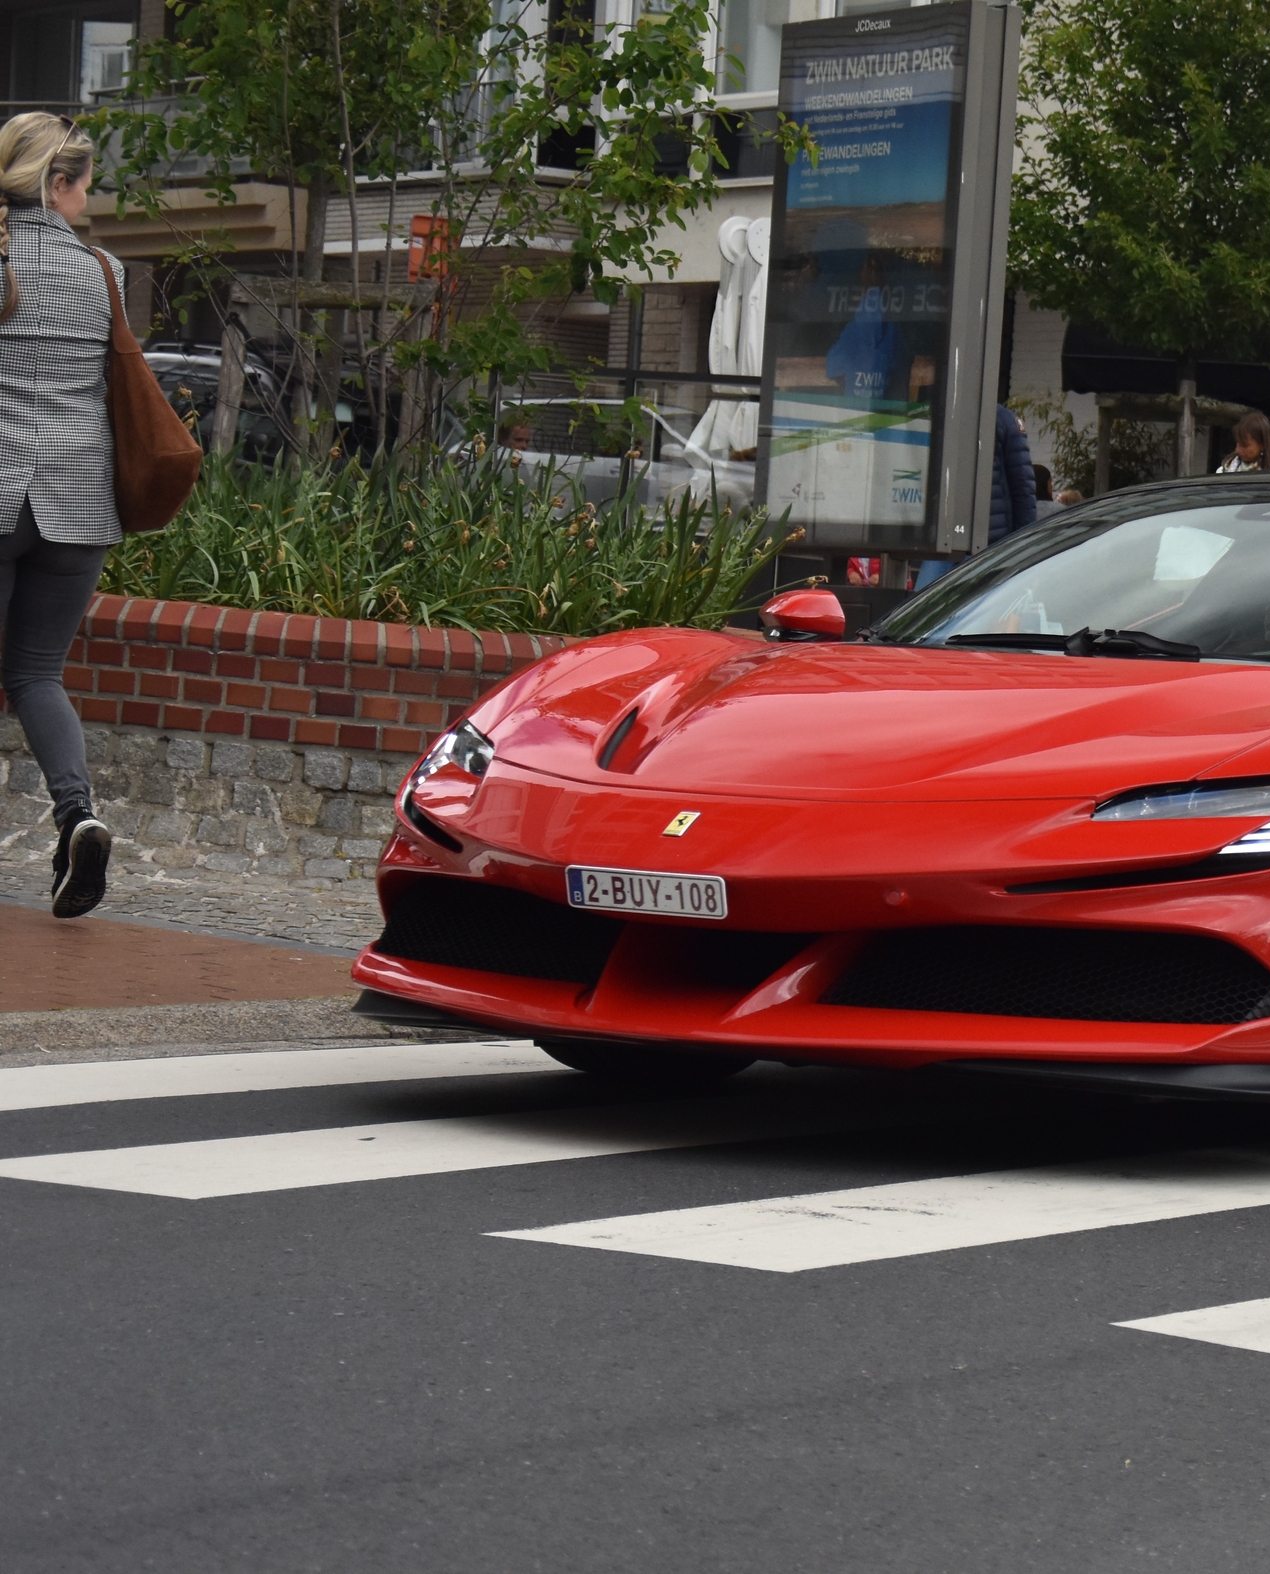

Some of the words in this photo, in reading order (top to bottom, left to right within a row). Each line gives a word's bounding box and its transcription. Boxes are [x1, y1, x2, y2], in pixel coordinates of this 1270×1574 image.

[855, 19, 891, 33] JCDecaux
[805, 58, 843, 85] ZWIN
[845, 51, 909, 80] NATUUR
[912, 45, 954, 73] PARK
[804, 86, 913, 111] WEEKENDWANDELINGEN
[802, 141, 891, 162] PÉWANDELINGEN
[891, 487, 922, 504] ZWIN
[954, 524, 965, 534] 44
[573, 890, 582, 902] B
[586, 874, 718, 913] 2-BUY-108
